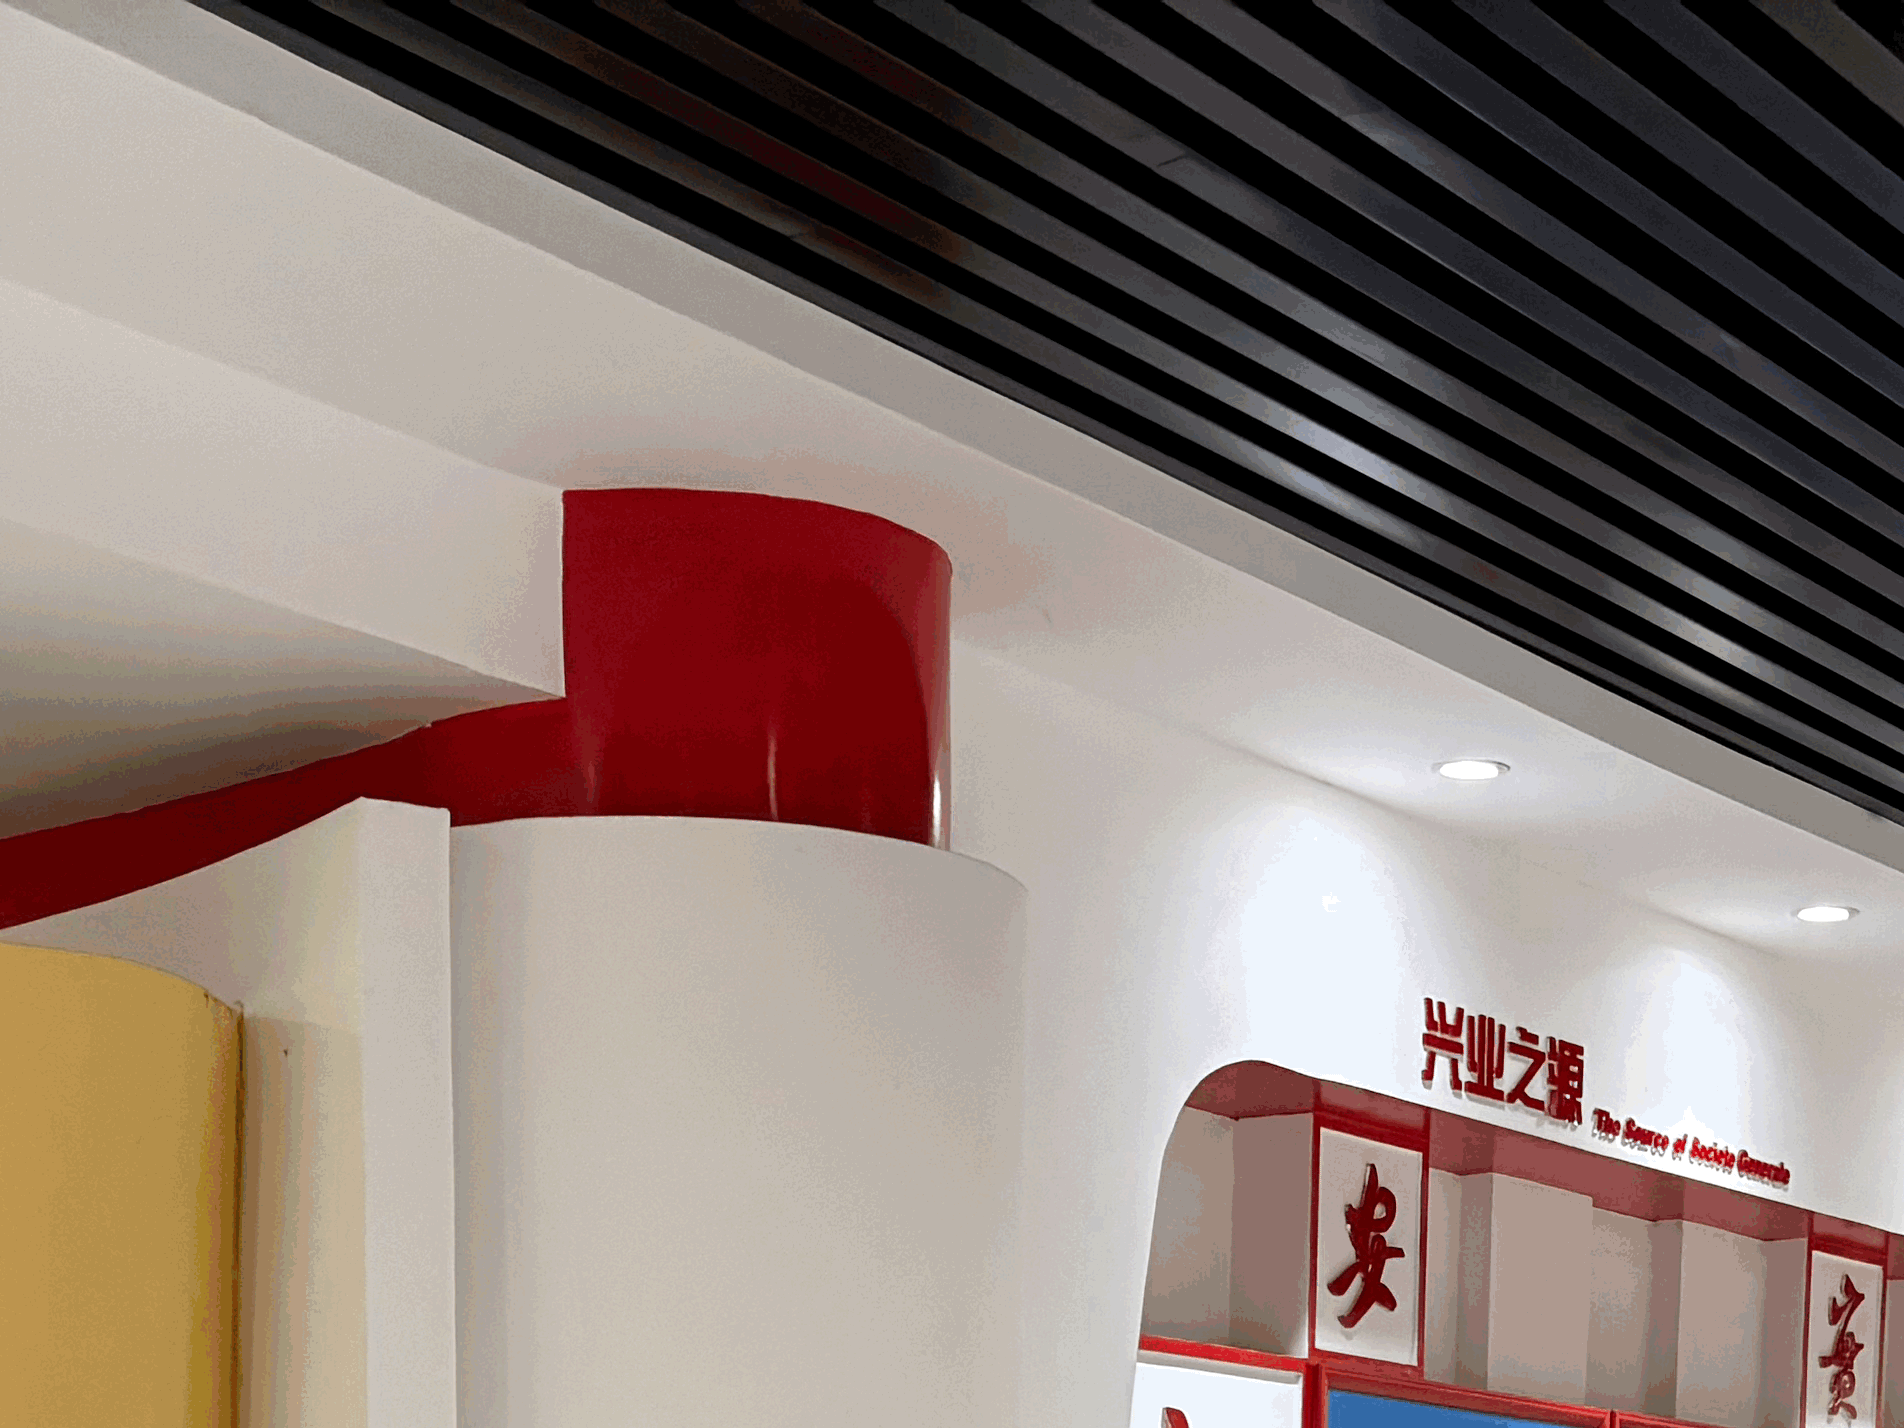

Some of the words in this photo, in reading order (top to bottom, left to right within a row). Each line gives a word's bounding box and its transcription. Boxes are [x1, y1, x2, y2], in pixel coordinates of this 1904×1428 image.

[1421, 997, 1584, 1125] 兴业之源
[1326, 1164, 1405, 1328] 安
